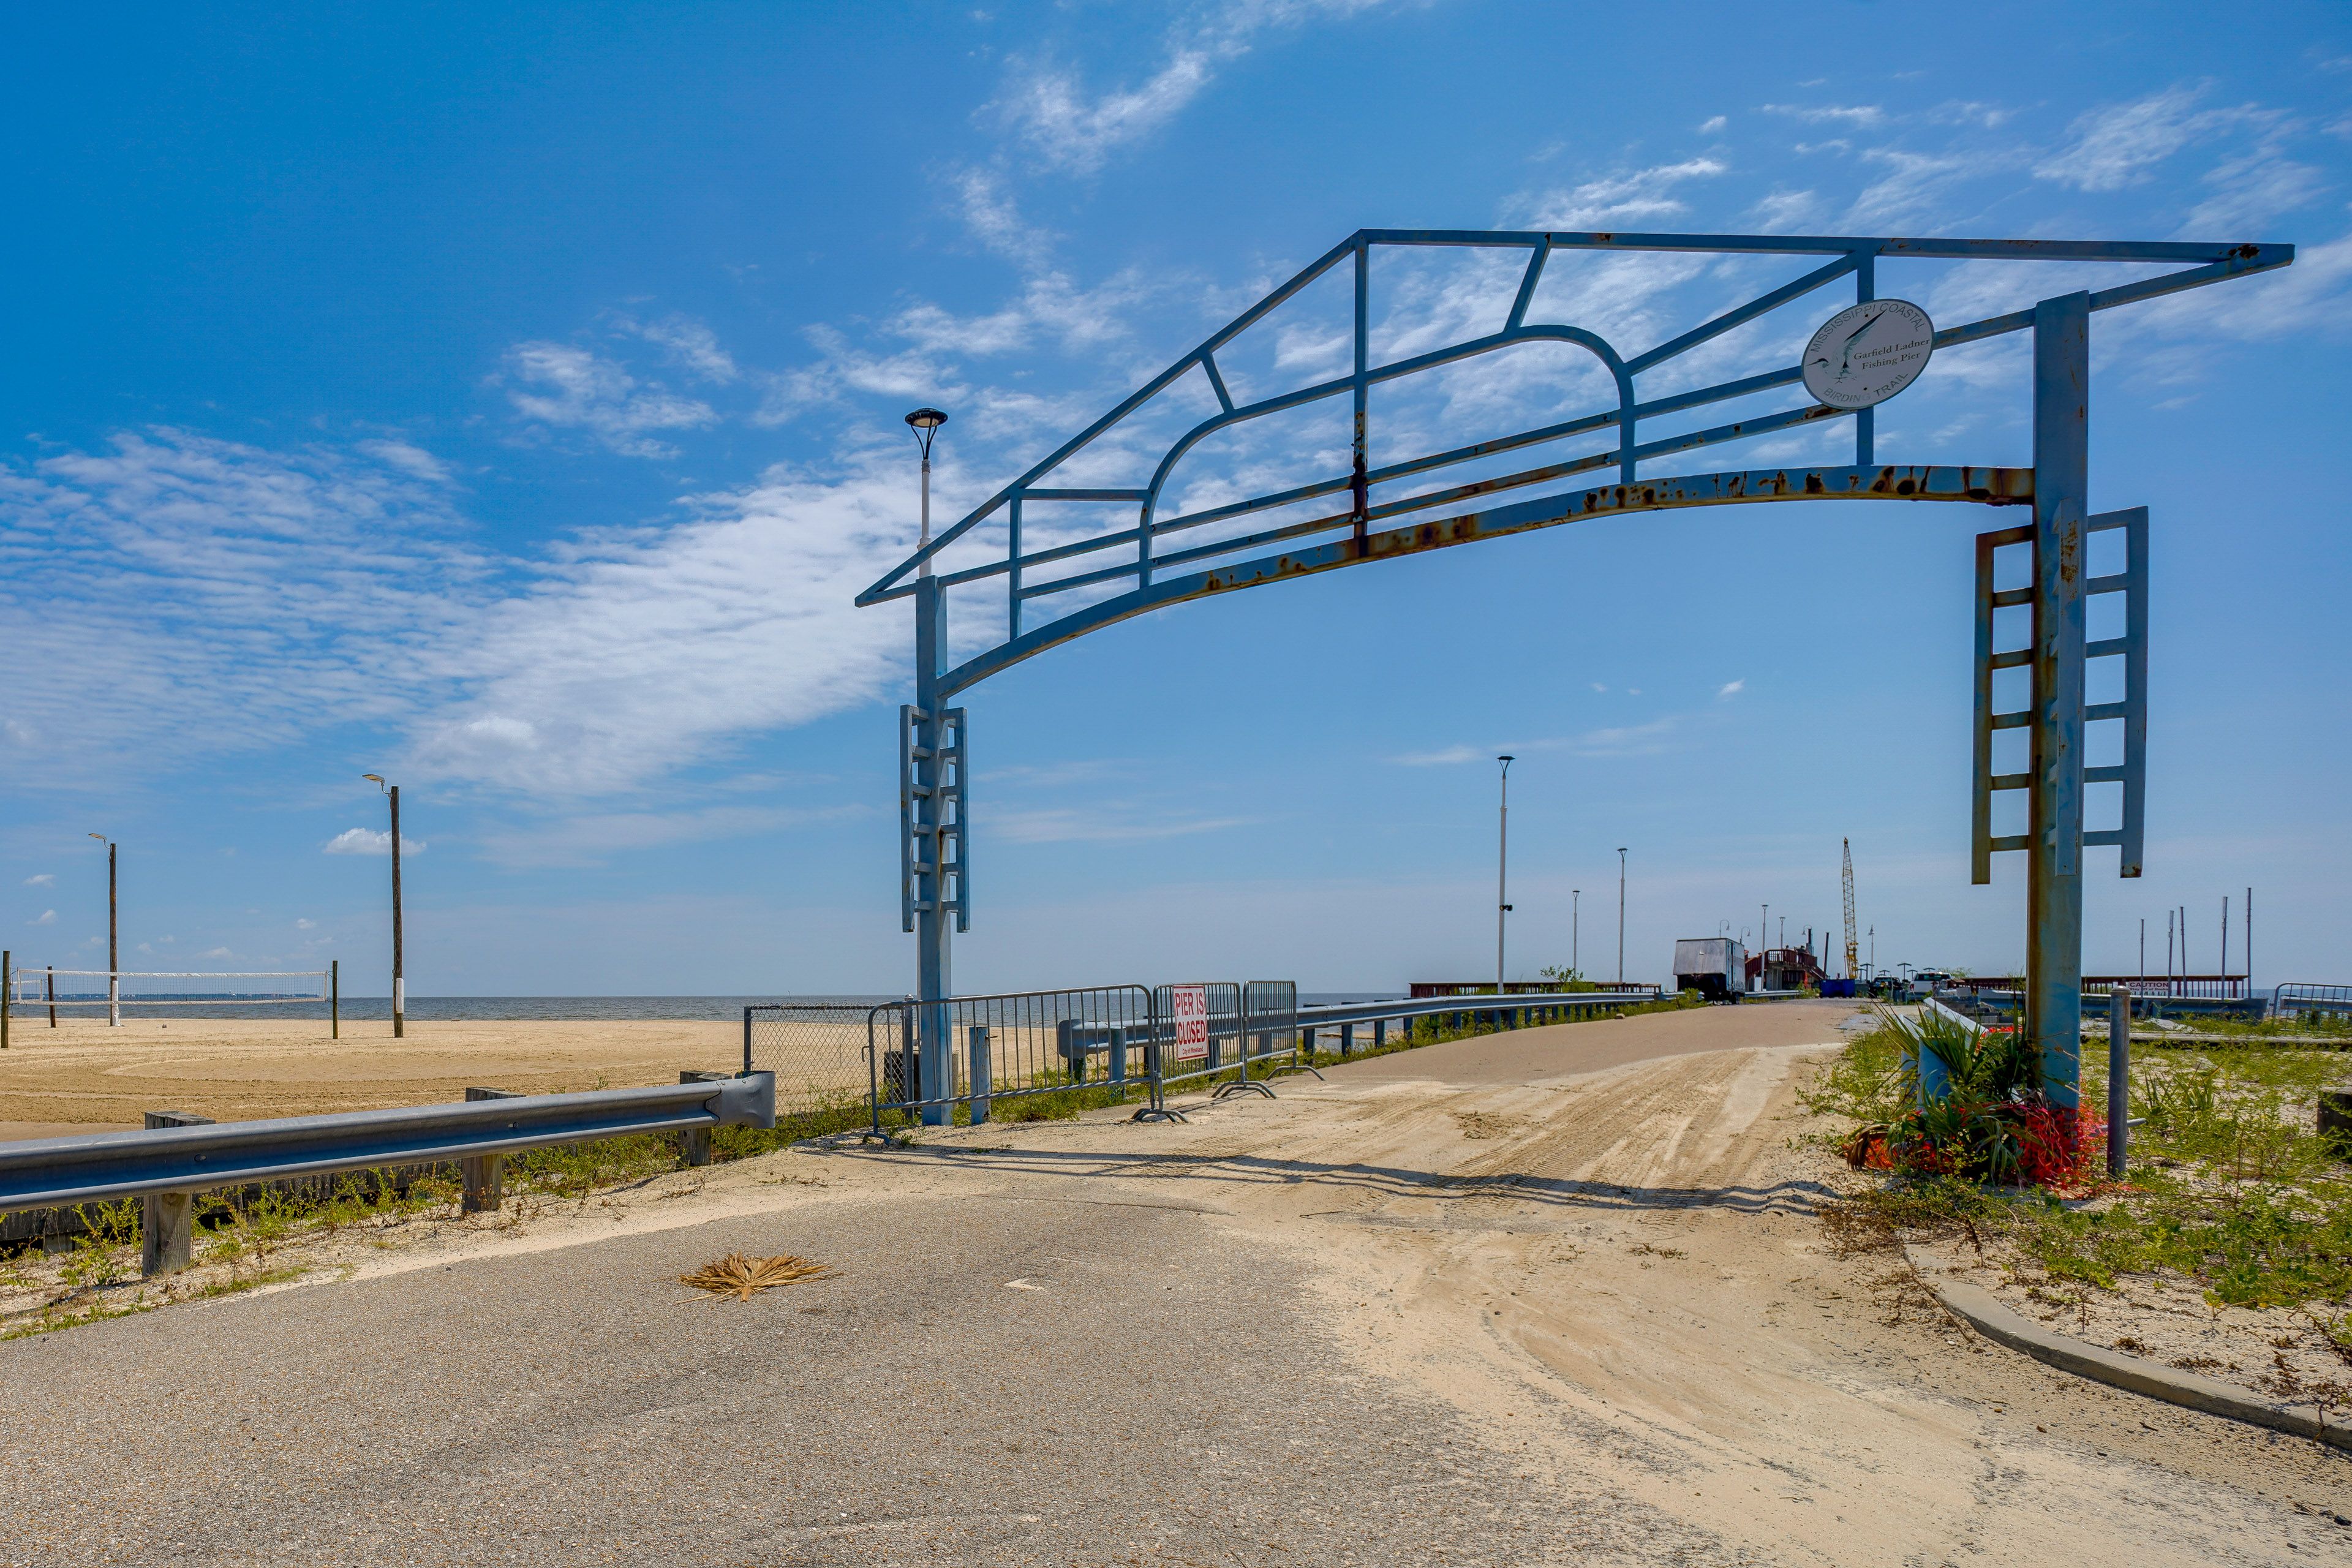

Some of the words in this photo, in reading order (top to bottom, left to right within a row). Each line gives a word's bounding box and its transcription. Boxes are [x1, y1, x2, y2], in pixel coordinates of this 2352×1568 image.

[1811, 304, 1875, 352] MISSISSIPPI
[1880, 303, 1925, 332] COASTAL
[1853, 345, 1892, 360] Garfield
[1894, 339, 1930, 352] Ladner
[1861, 358, 1898, 370] Fishing
[1901, 353, 1921, 362] Pier
[1873, 372, 1909, 397] TRAIL
[1175, 992, 1194, 1016] PIER
[1196, 992, 1204, 1016] IS
[1178, 1020, 1205, 1046] CLOSED
